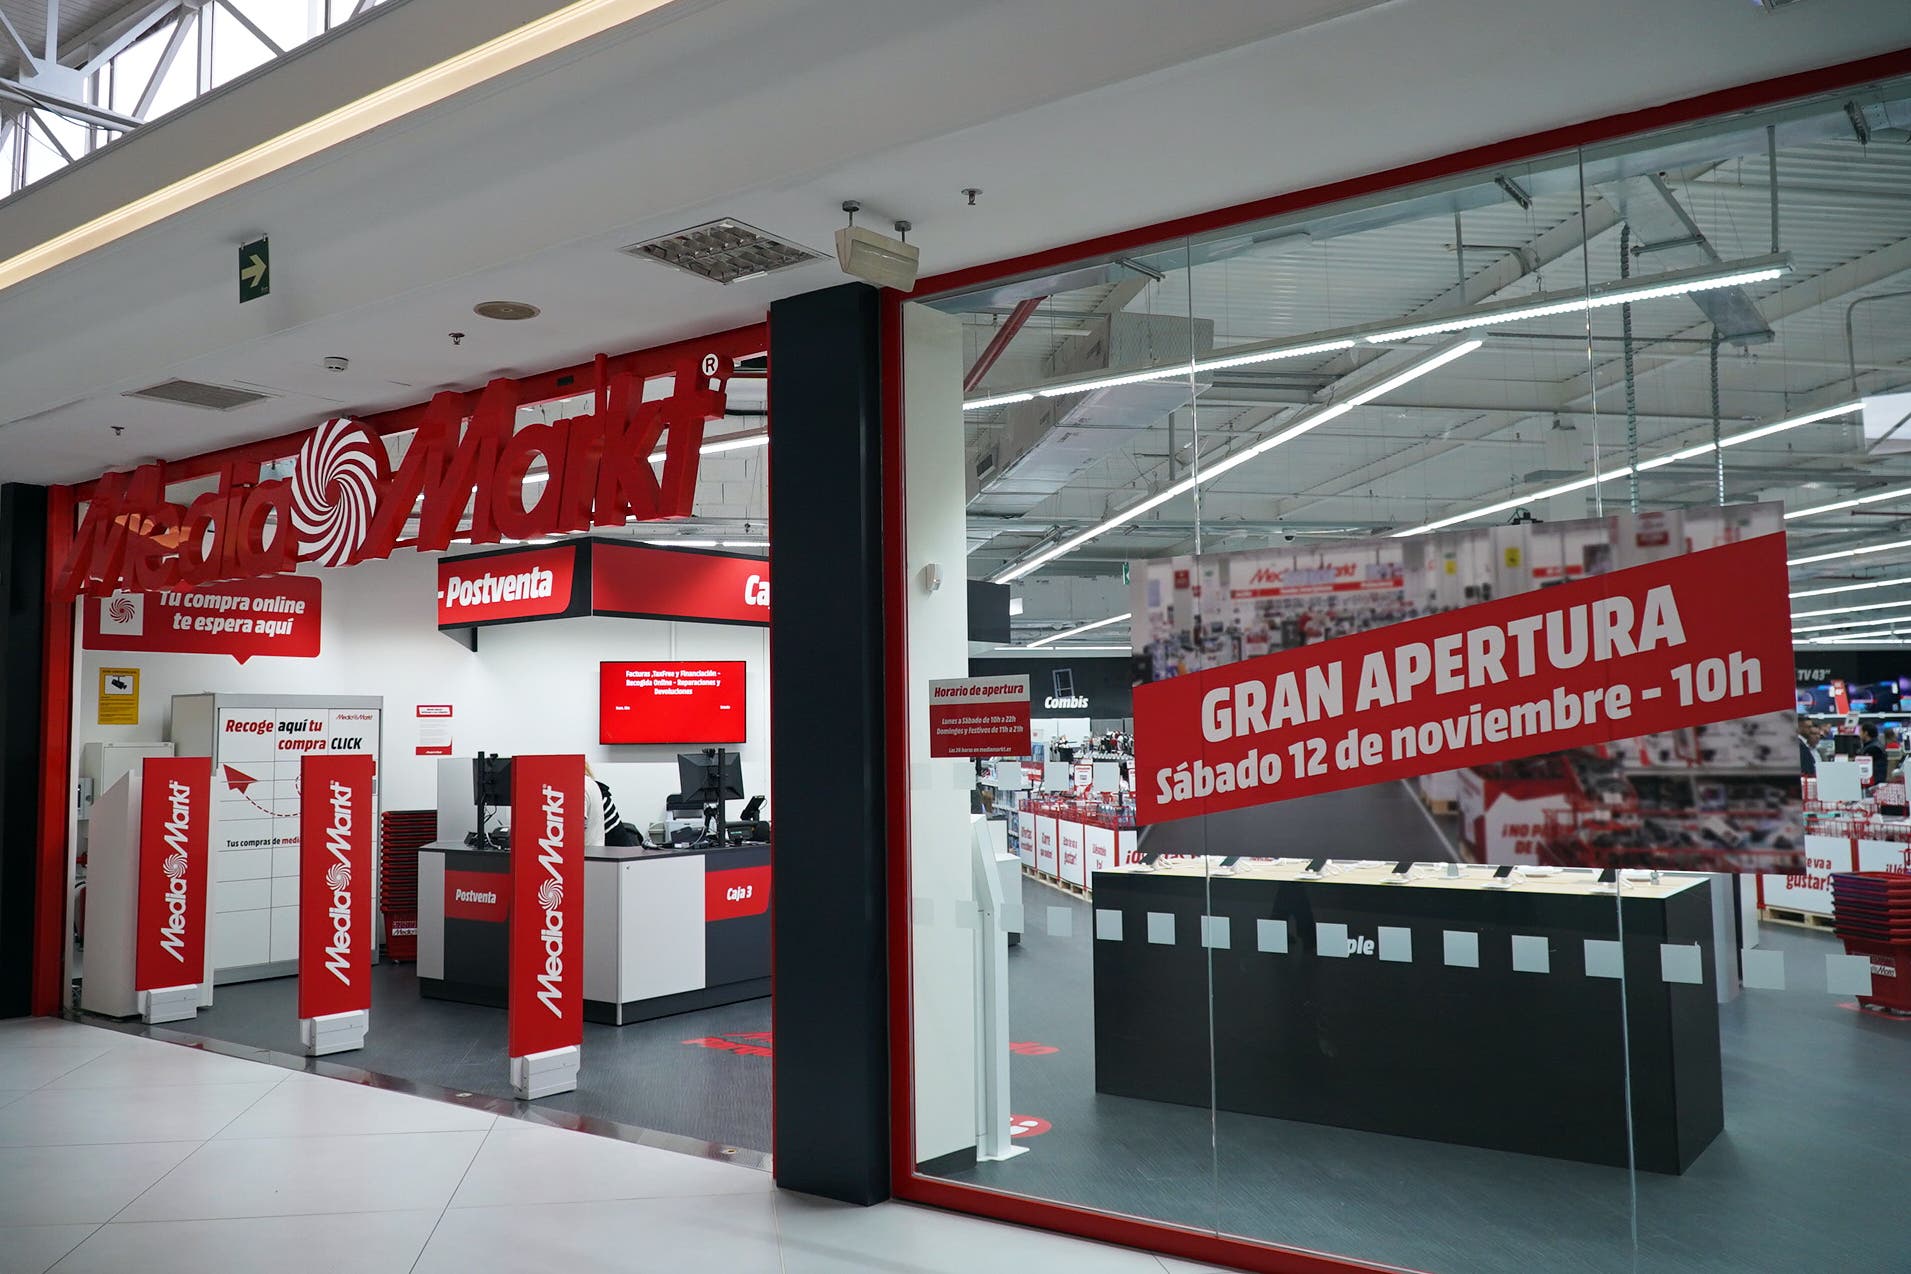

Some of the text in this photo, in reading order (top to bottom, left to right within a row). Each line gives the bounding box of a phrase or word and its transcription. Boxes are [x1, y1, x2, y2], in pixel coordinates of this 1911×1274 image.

[446, 566, 553, 608] Postventa
[744, 574, 770, 610] Ca
[160, 590, 306, 614] Tu compra online
[172, 612, 294, 637] te espera aquí
[1202, 580, 1686, 743] GRAN APERTURA
[1798, 669, 1812, 680] TV
[934, 683, 1024, 697] Horario de apertura
[1045, 696, 1089, 709] Combis
[225, 718, 323, 735] Recoge aquí tu
[1157, 749, 1282, 804] Sábado
[1288, 737, 1328, 778] 12
[1335, 728, 1383, 771] de
[1391, 683, 1631, 760] noviembre
[1671, 650, 1762, 707] 10h
[278, 737, 362, 752] compra CLICK
[227, 840, 239, 848] Tus
[240, 839, 271, 848] compras
[272, 837, 280, 845] de
[1814, 859, 1825, 869] va
[1826, 860, 1832, 870] a
[455, 888, 497, 904] Postventa
[726, 884, 753, 902] Caja 3
[1347, 935, 1375, 955] ple
